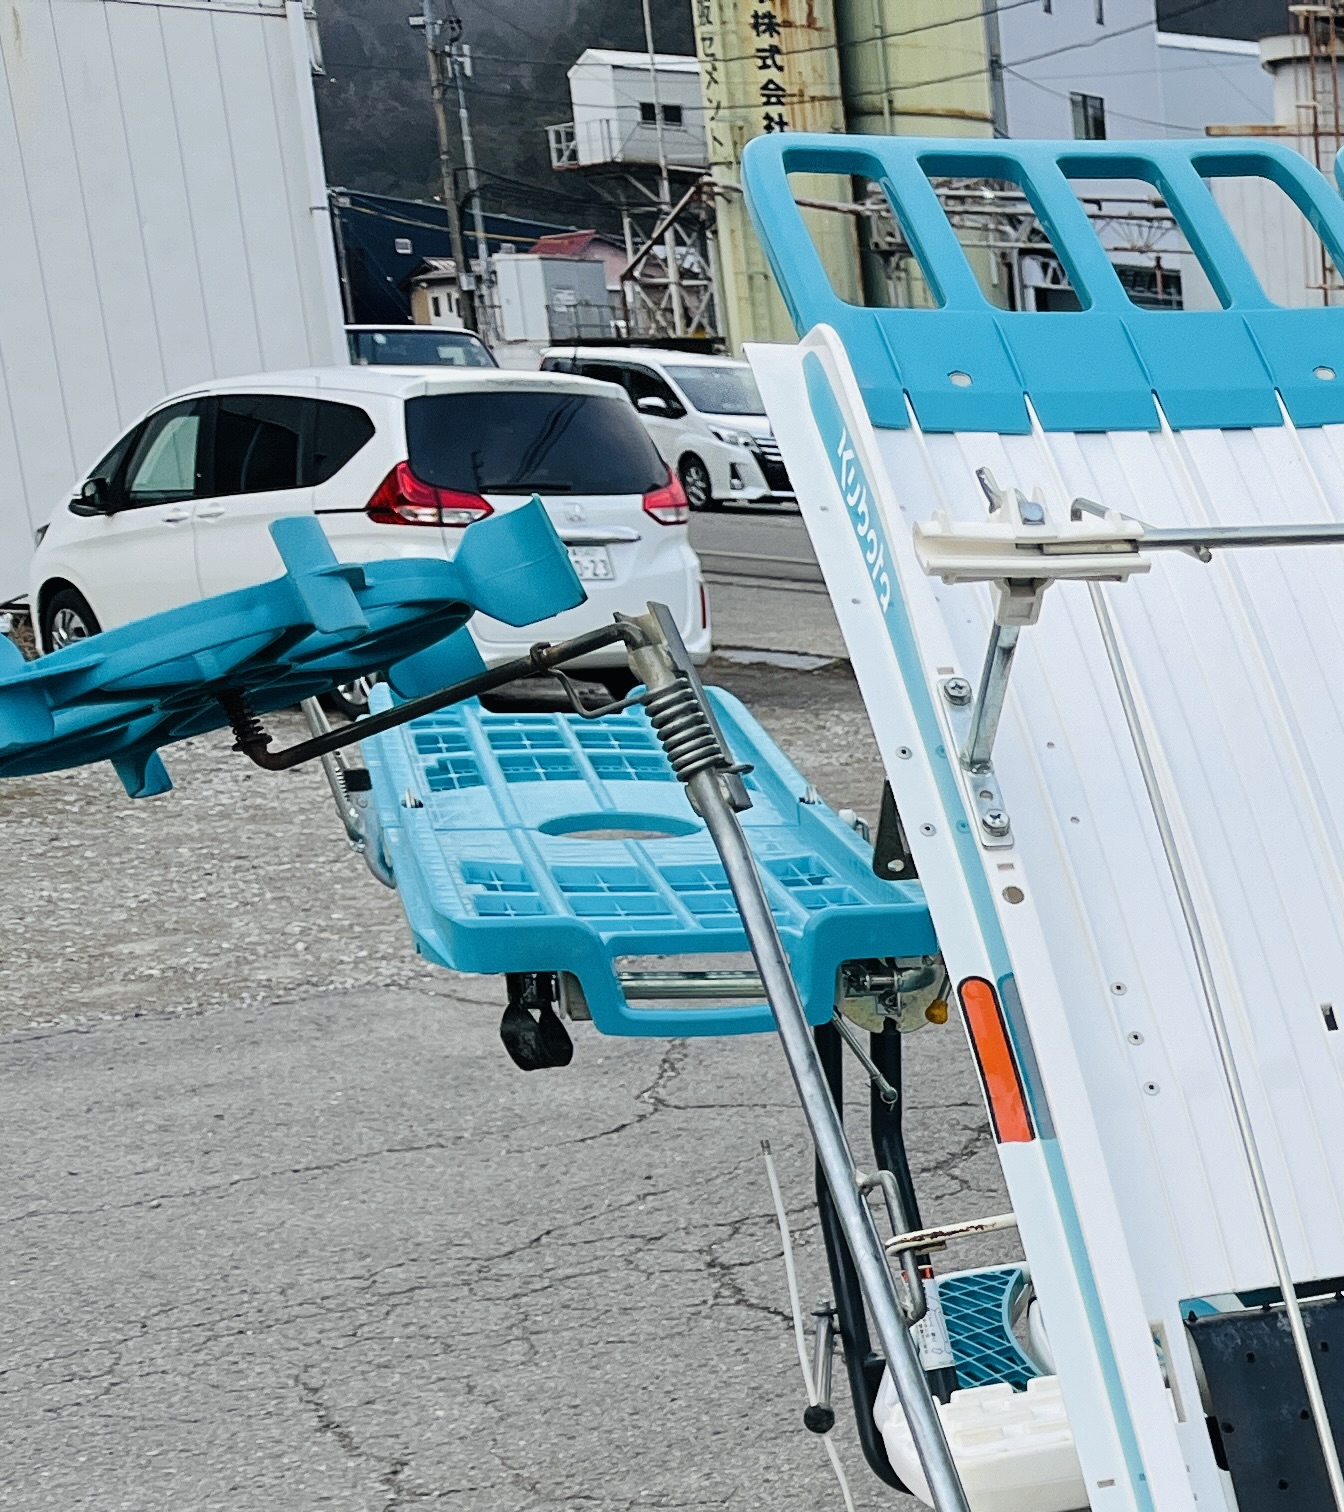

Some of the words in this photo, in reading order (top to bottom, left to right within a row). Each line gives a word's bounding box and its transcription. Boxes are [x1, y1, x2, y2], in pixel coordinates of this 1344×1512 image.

[751, 0, 789, 134] 株式会社
[837, 426, 892, 615] Kubota
